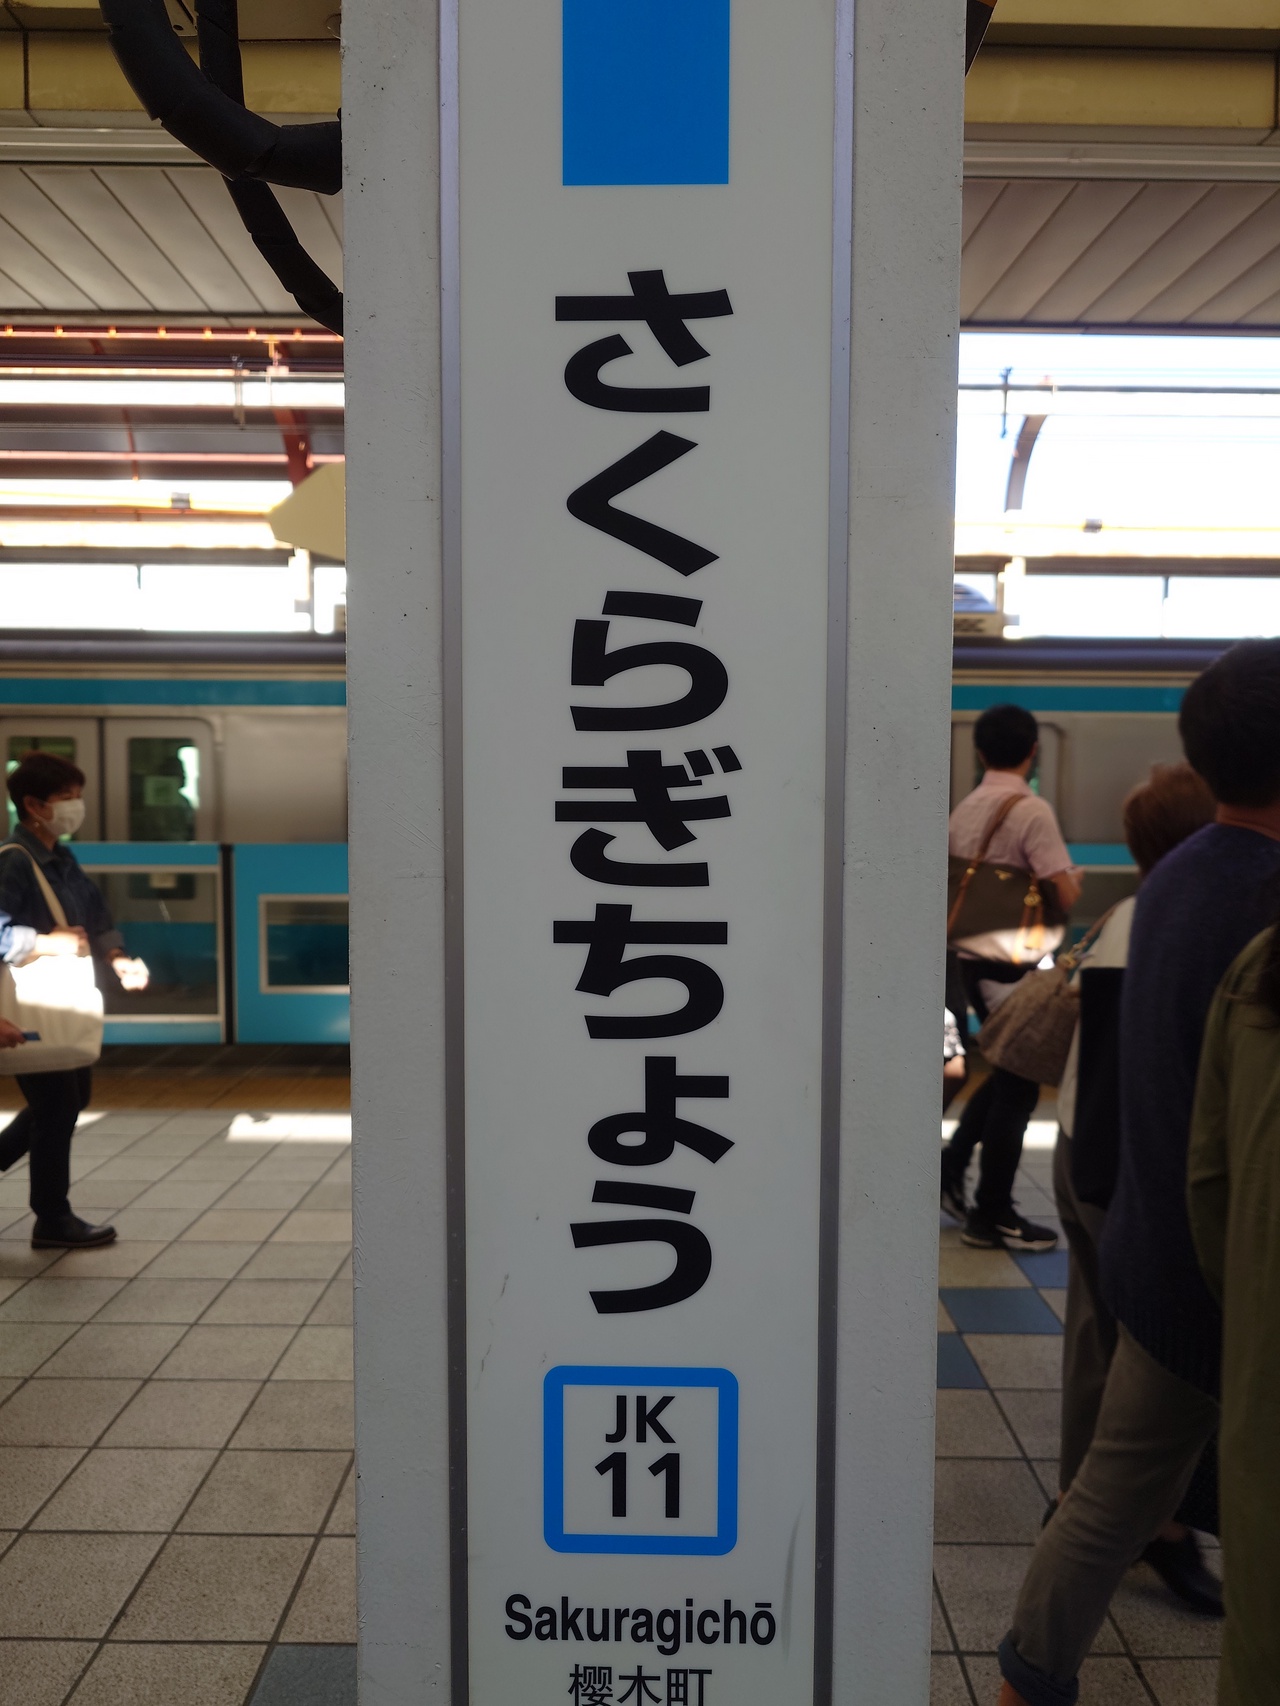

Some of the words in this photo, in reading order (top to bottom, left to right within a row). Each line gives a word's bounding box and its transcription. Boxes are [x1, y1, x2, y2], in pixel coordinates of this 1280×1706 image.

[554, 270, 742, 1314] さくらぎちょう
[605, 1395, 676, 1444] JK
[594, 1452, 681, 1519] 11
[505, 1593, 776, 1656] Sakuragichō
